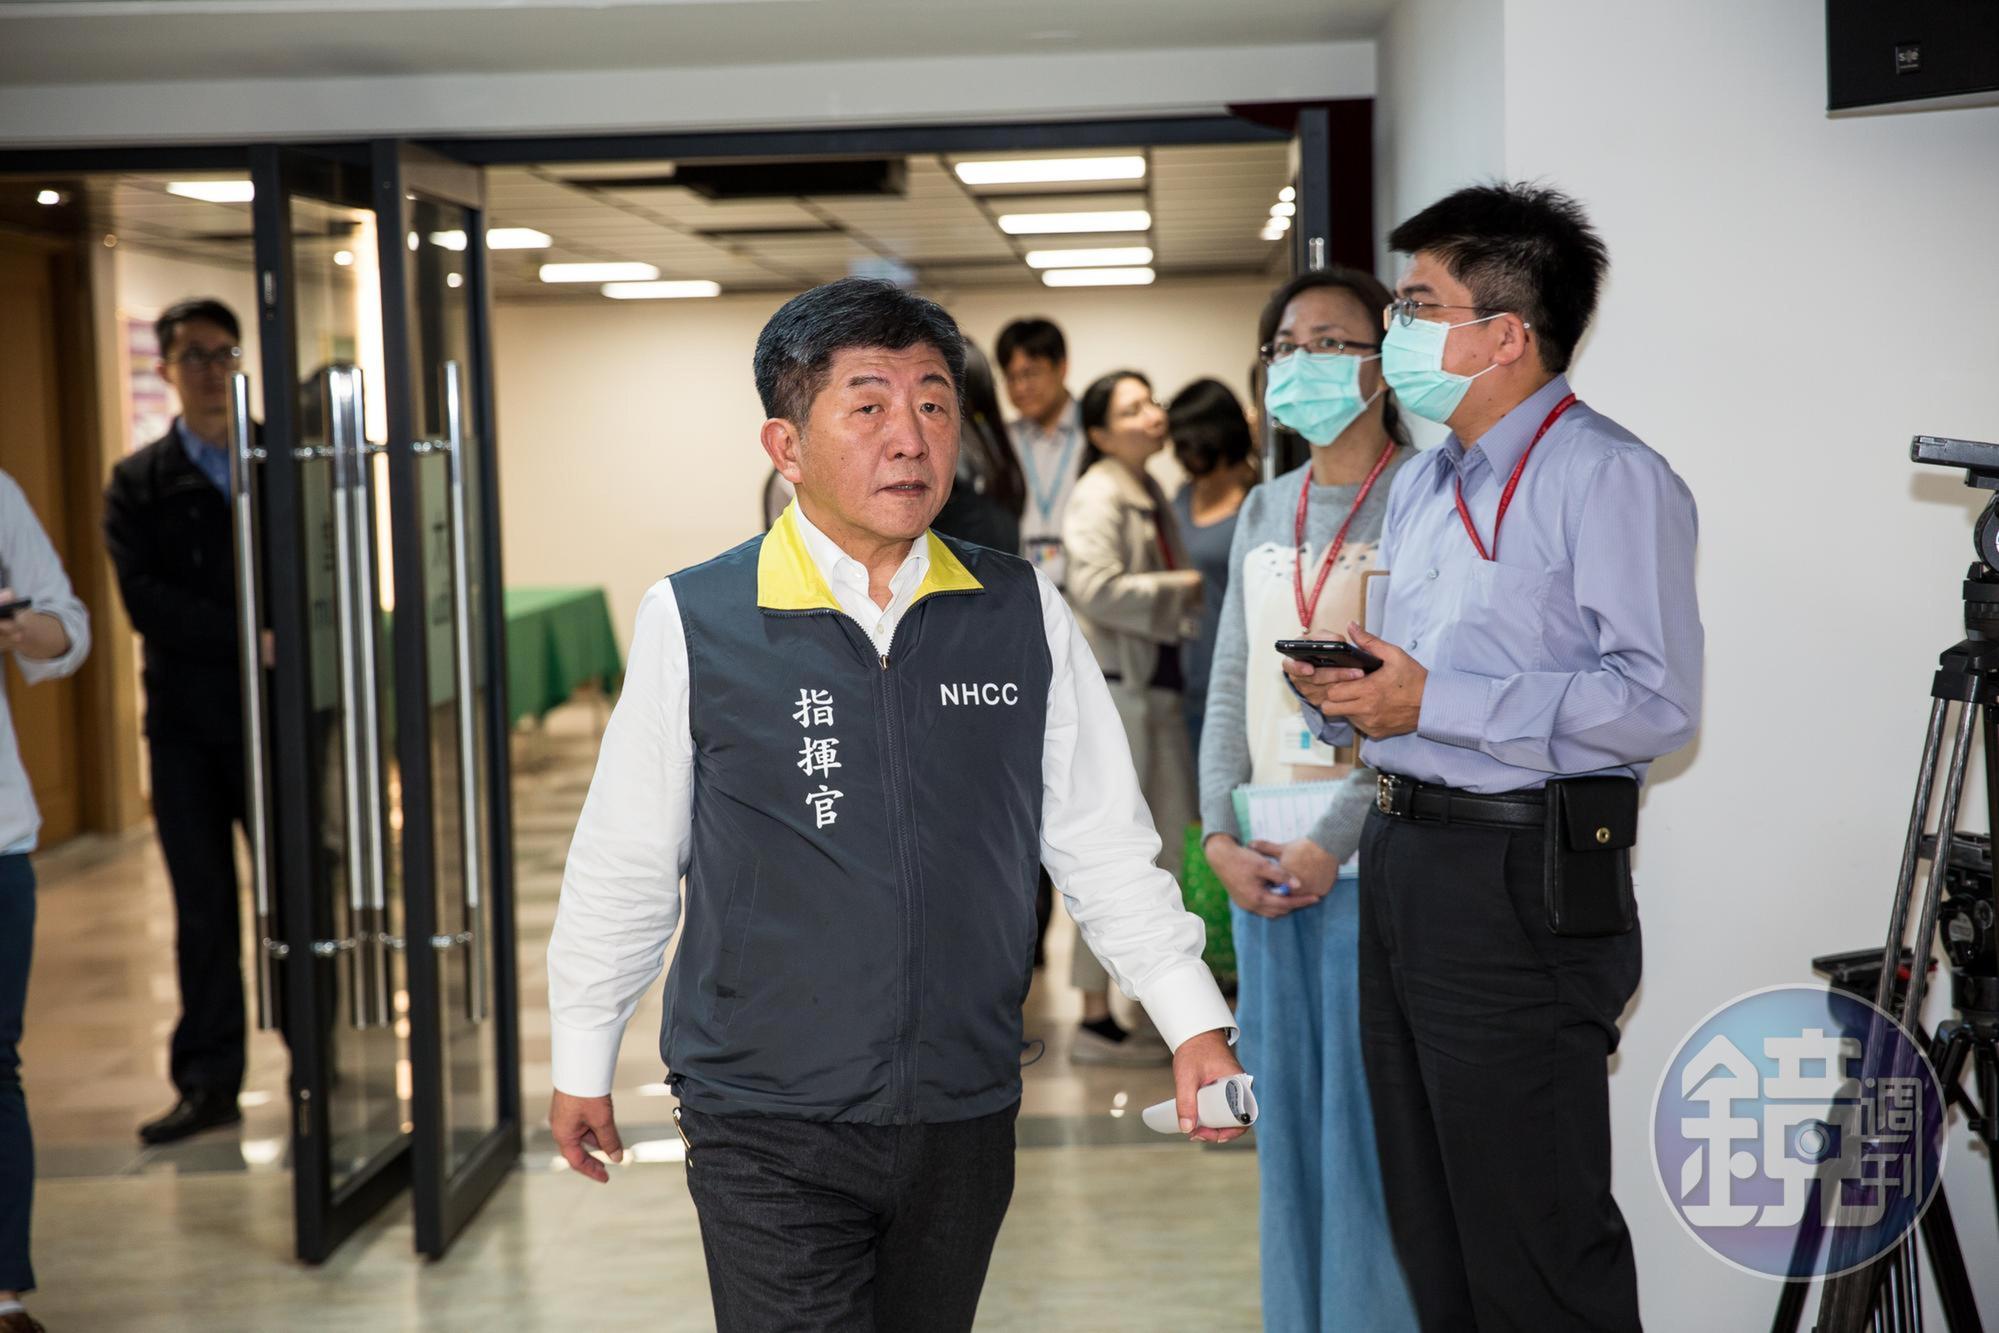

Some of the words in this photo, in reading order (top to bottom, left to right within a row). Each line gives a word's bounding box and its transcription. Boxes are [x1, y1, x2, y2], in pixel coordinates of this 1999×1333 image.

[940, 682, 1019, 706] NHCC
[792, 688, 845, 829] 指揮官
